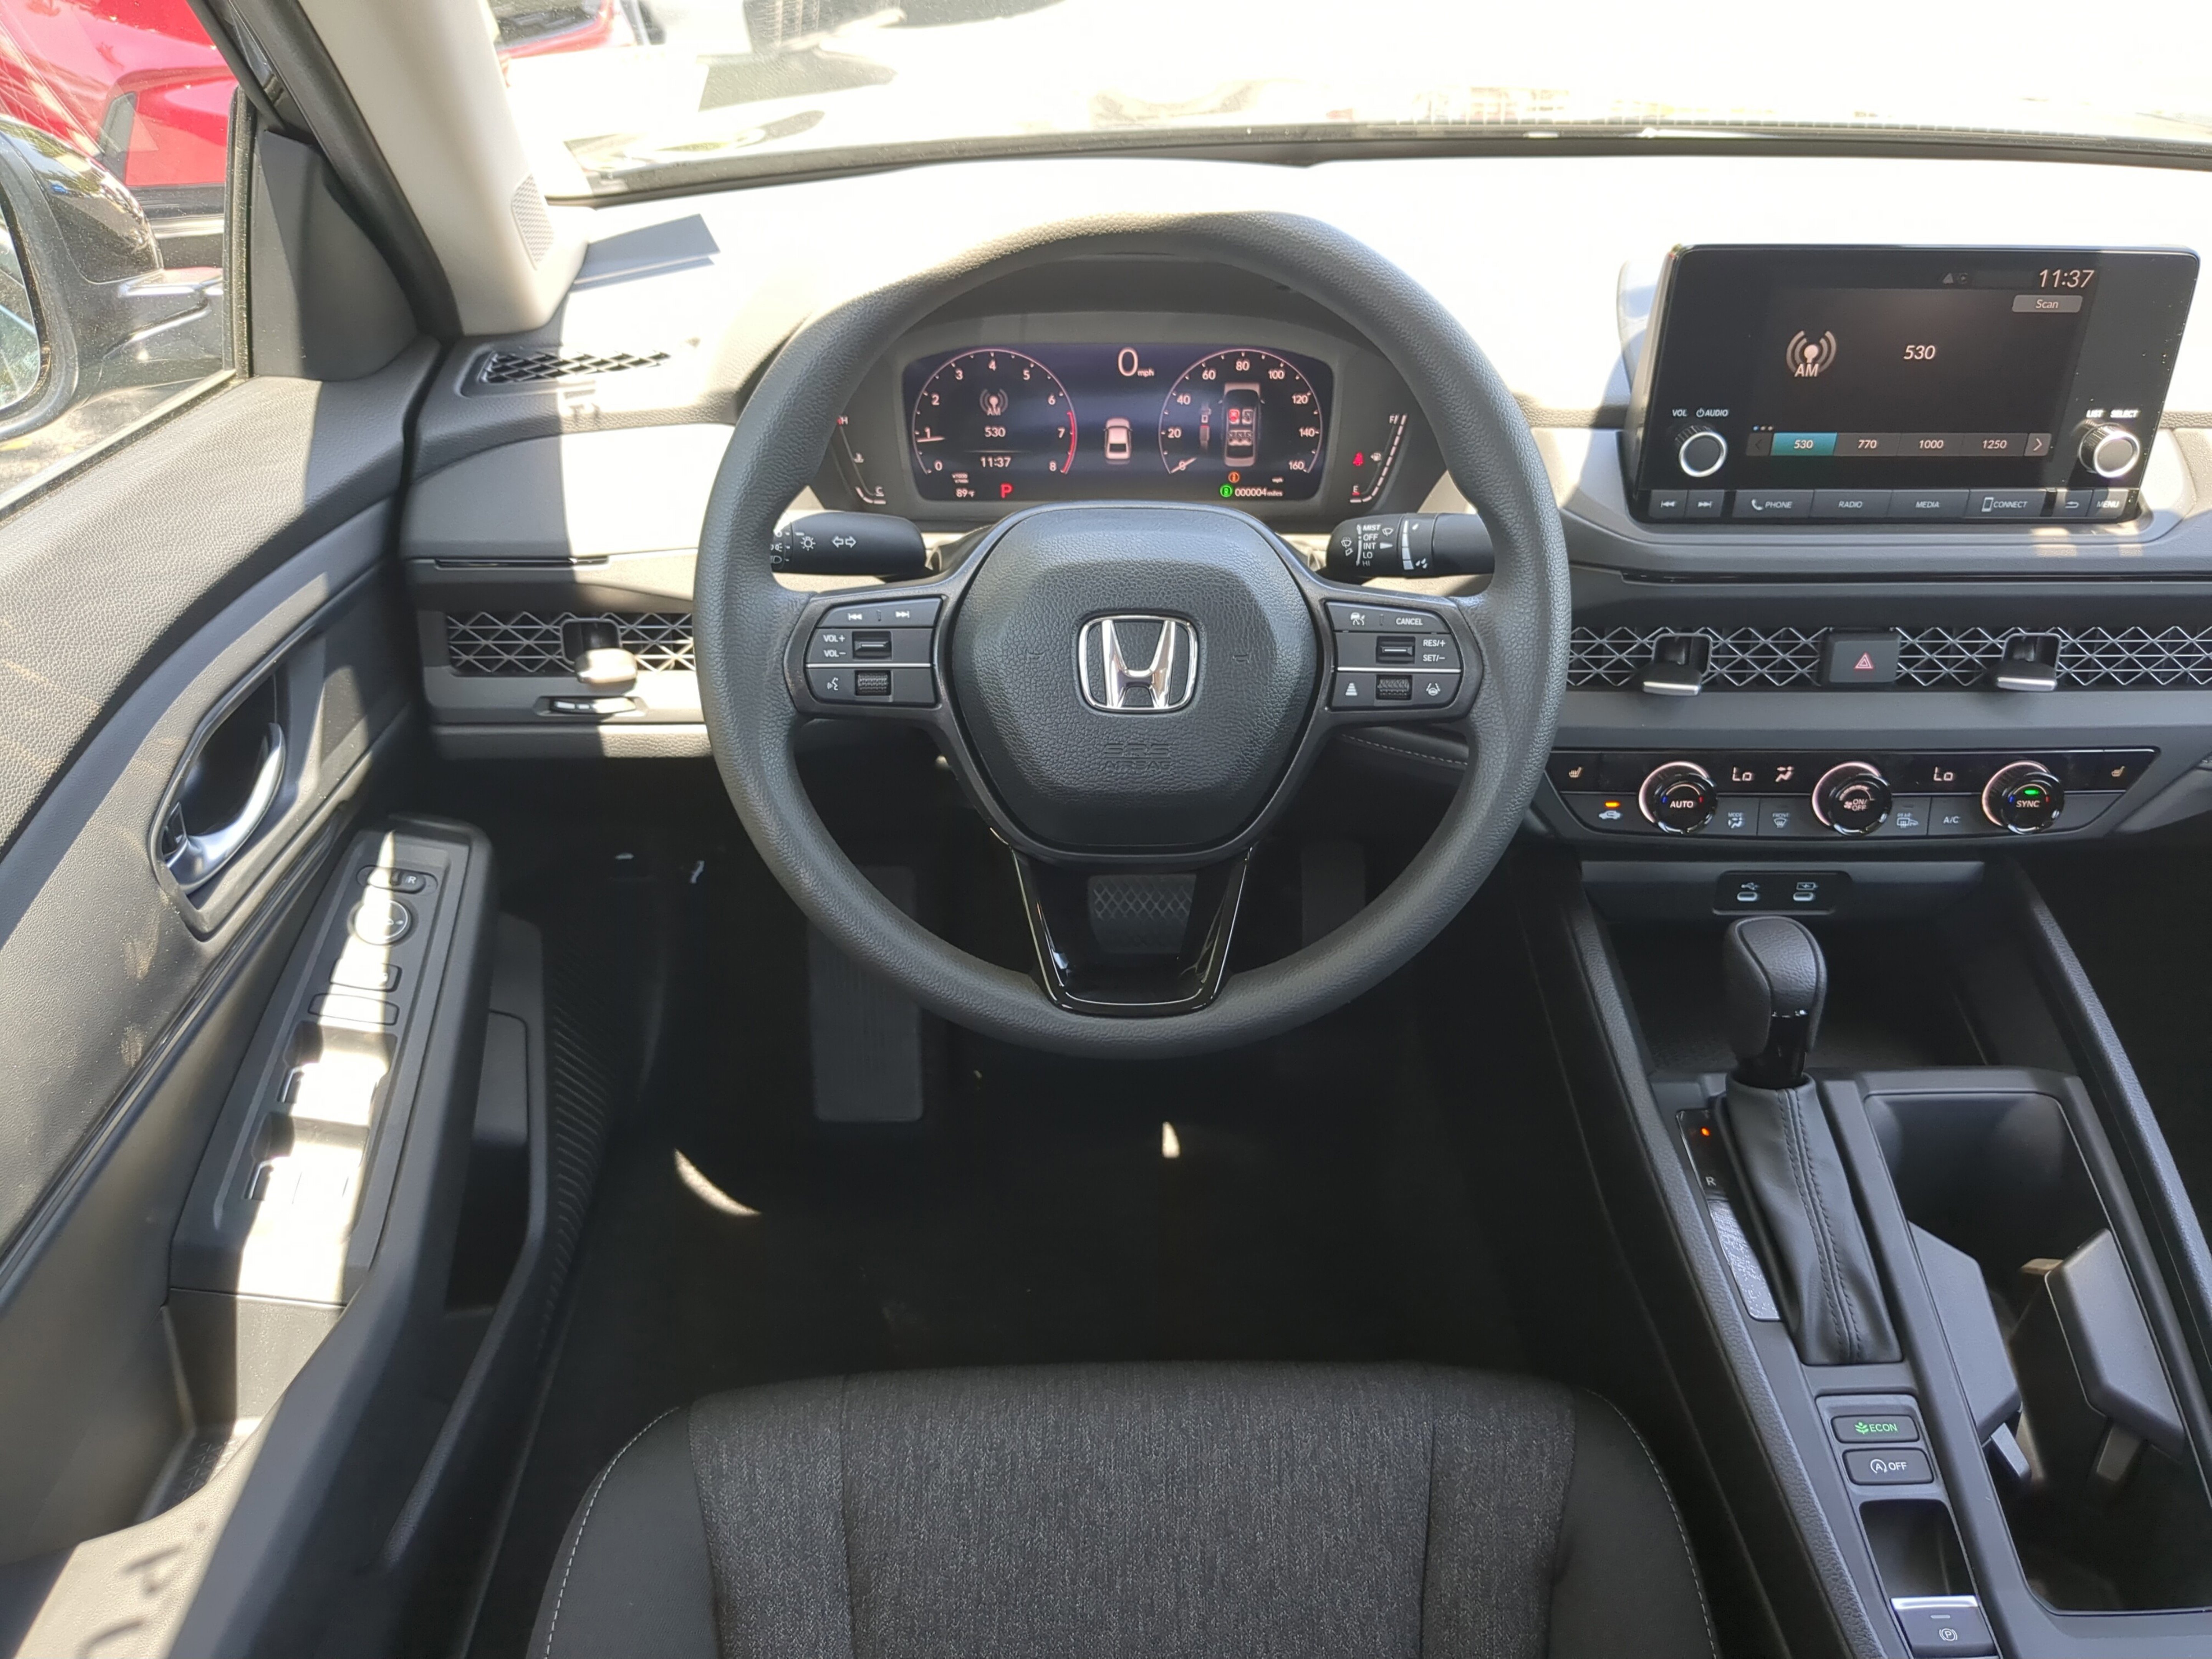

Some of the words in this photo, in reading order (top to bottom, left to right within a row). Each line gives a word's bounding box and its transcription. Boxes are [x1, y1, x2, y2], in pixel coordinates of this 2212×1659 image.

[2039, 269, 2094, 288] 11:37
[2035, 299, 2059, 309] Scan
[1903, 345, 1936, 360] 530
[988, 360, 996, 371] 4
[1118, 347, 1138, 376] 0
[1137, 368, 1154, 377] mph
[1235, 360, 1250, 371] 80
[955, 369, 964, 380] 3
[1023, 369, 1031, 380] 5
[1202, 369, 1217, 380] 60
[1269, 369, 1285, 380] 100
[1794, 364, 1820, 377] AM
[932, 394, 940, 406] 2
[1048, 394, 1056, 405] 6
[1177, 394, 1191, 405] 40
[1292, 394, 1308, 405] 120
[985, 427, 1006, 437] 530
[1058, 427, 1065, 438] 7
[1168, 428, 1182, 438] 20
[1299, 427, 1315, 437] 140
[1794, 440, 1813, 449] 530
[1858, 440, 1877, 449] 770
[1919, 440, 1944, 449] 1000
[1982, 440, 2007, 449] 1250
[934, 460, 943, 471] 0
[980, 457, 1011, 467] 11:37
[1049, 461, 1057, 471] 8
[1288, 460, 1305, 471] 160
[1001, 484, 1013, 498] P
[1765, 501, 1792, 509] PHONE
[1838, 500, 1863, 508] RADIO
[1993, 500, 2028, 508] CONNECT
[1706, 1176, 1716, 1186] R
[1870, 1423, 1897, 1432] ECON
[1889, 1462, 1906, 1470] OFF
